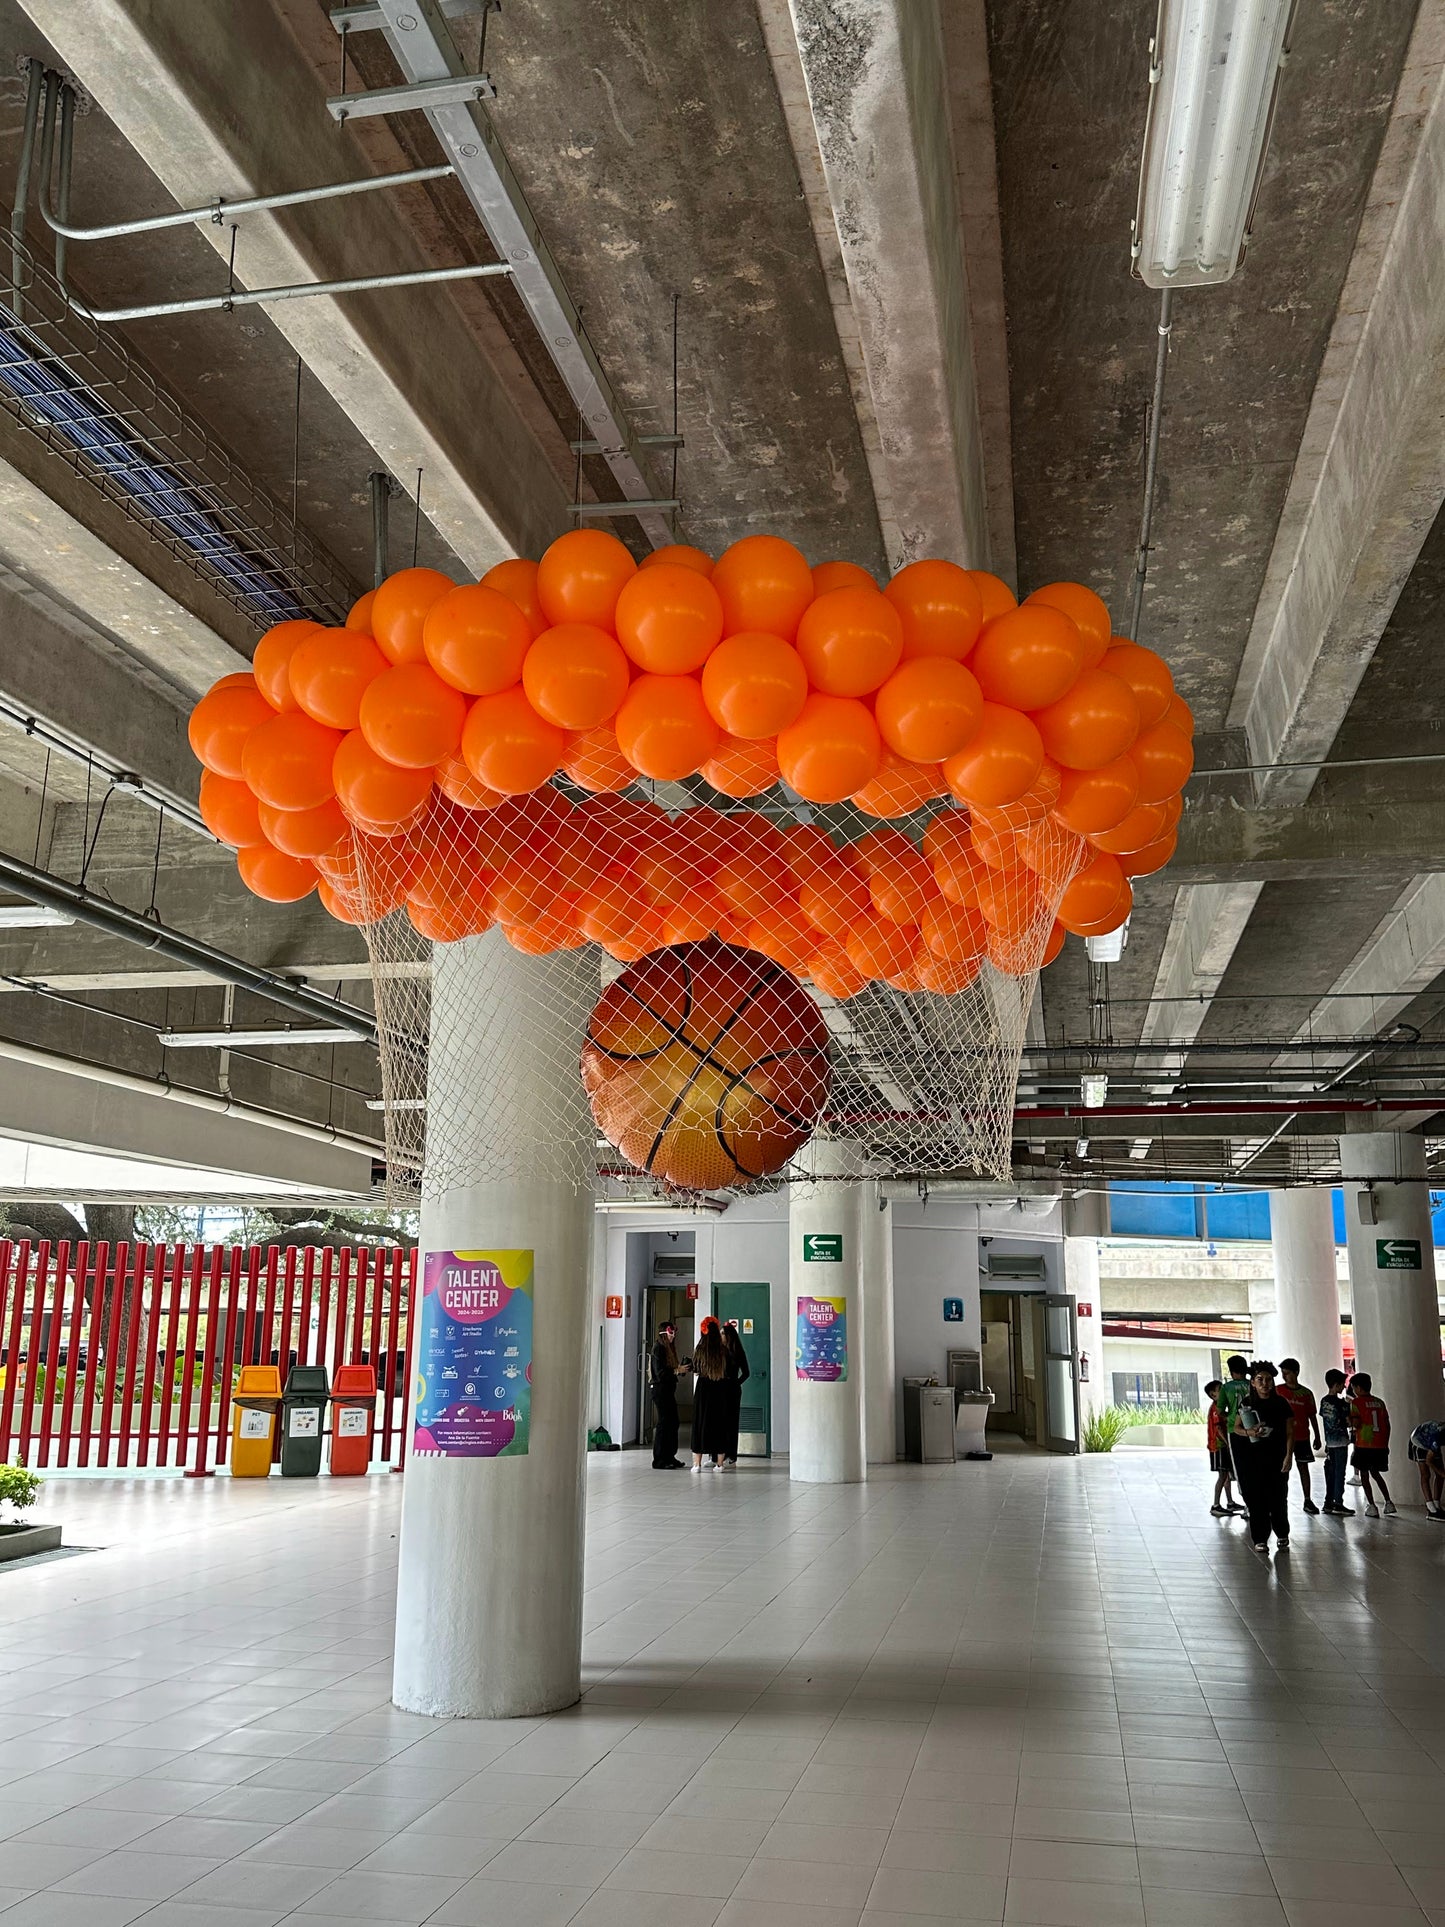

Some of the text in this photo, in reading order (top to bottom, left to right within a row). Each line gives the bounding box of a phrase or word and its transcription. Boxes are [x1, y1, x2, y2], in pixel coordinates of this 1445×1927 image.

[447, 1269, 499, 1288] TALENT
[446, 1289, 499, 1308] CENTER
[809, 1304, 833, 1312] TALENT
[809, 1313, 834, 1321] CENTER
[1371, 1410, 1380, 1432] 1
